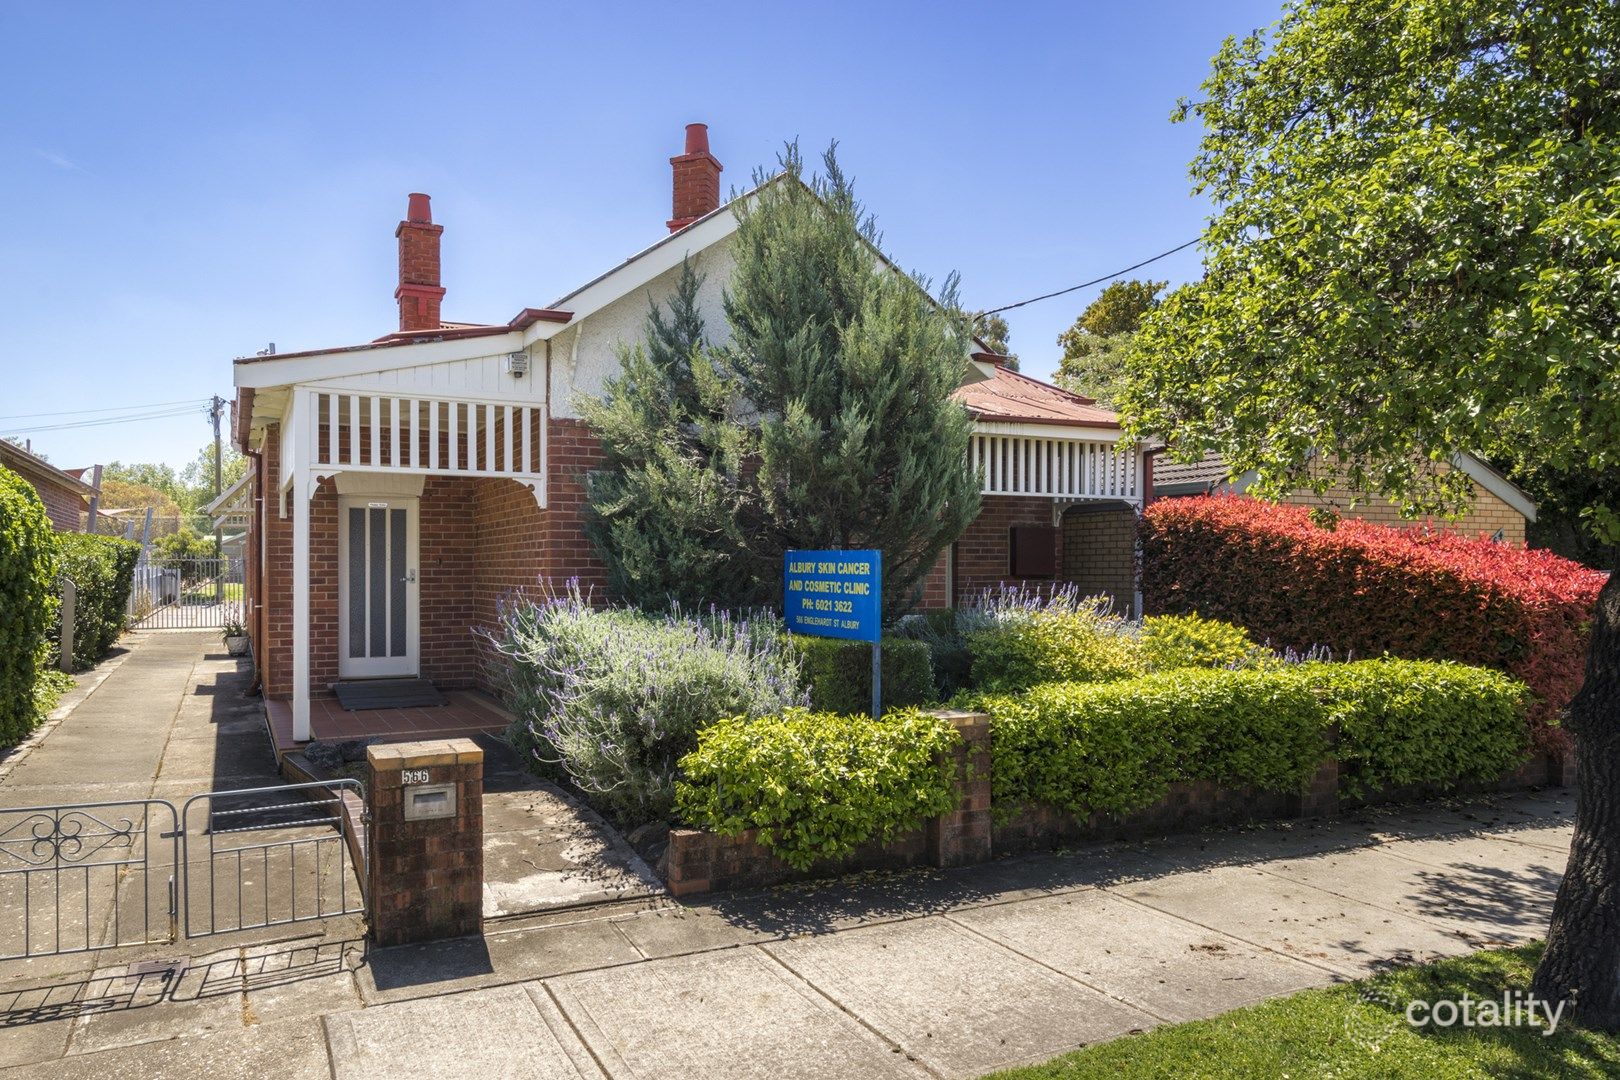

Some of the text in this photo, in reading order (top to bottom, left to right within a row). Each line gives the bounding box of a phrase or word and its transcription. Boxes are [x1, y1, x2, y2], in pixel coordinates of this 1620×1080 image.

[789, 562, 870, 575] ALBURY SKIN CANCER
[789, 580, 870, 595] AND COSMETIC CLINIC
[802, 598, 852, 613] PH: 6021 3622
[834, 619, 840, 628] ST
[840, 620, 860, 630] ALBURY
[402, 770, 429, 784] 566
